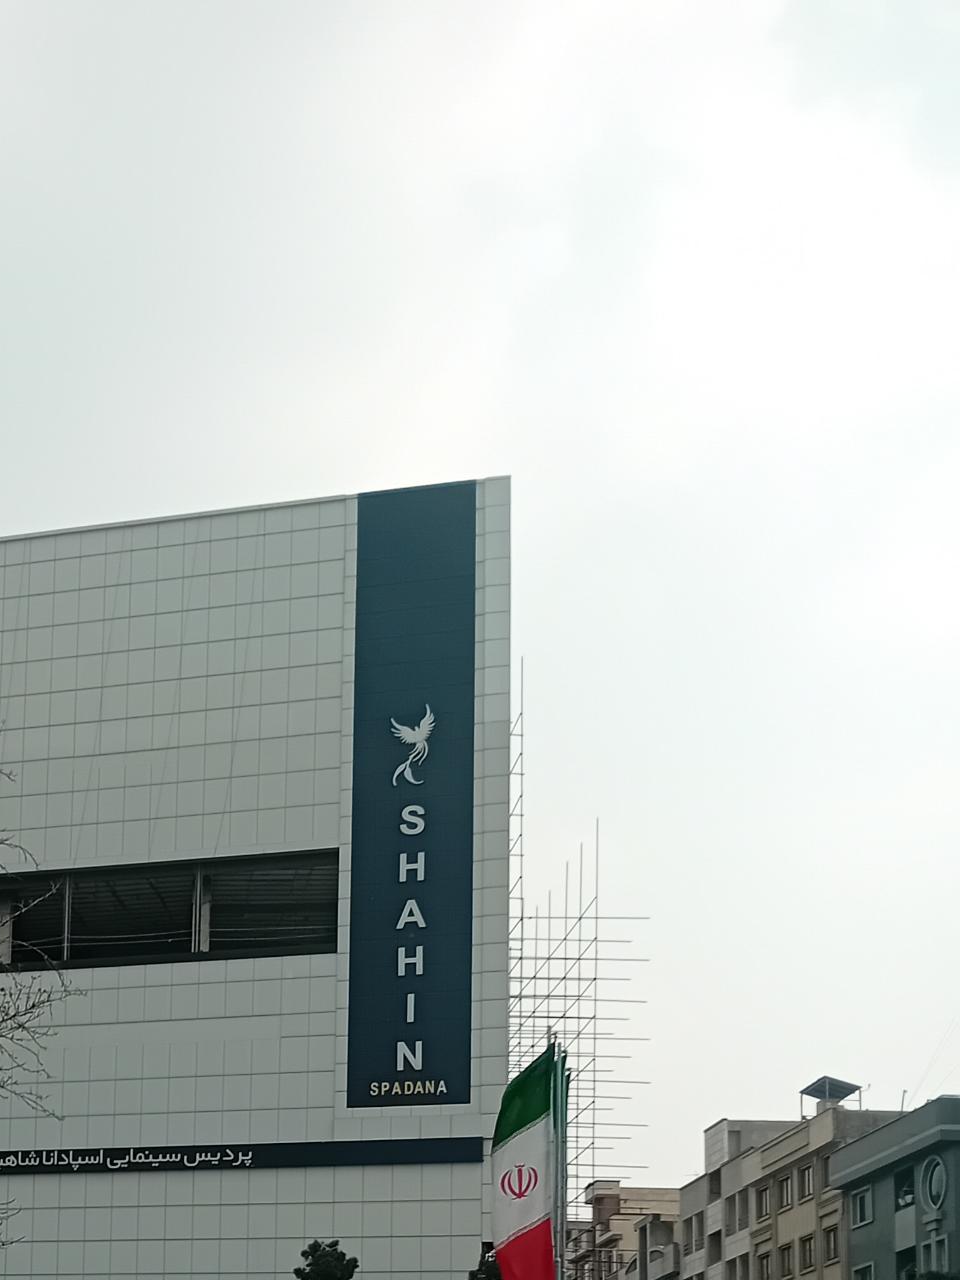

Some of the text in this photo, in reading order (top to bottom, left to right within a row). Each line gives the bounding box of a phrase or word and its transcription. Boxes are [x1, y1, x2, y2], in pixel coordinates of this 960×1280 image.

[395, 804, 427, 1072] SHAHIN
[369, 1080, 447, 1096] SPADANA
[42, 1149, 104, 1171] اسپادانا
[106, 1148, 181, 1169] سینمایی
[183, 1148, 253, 1167] پردیس
